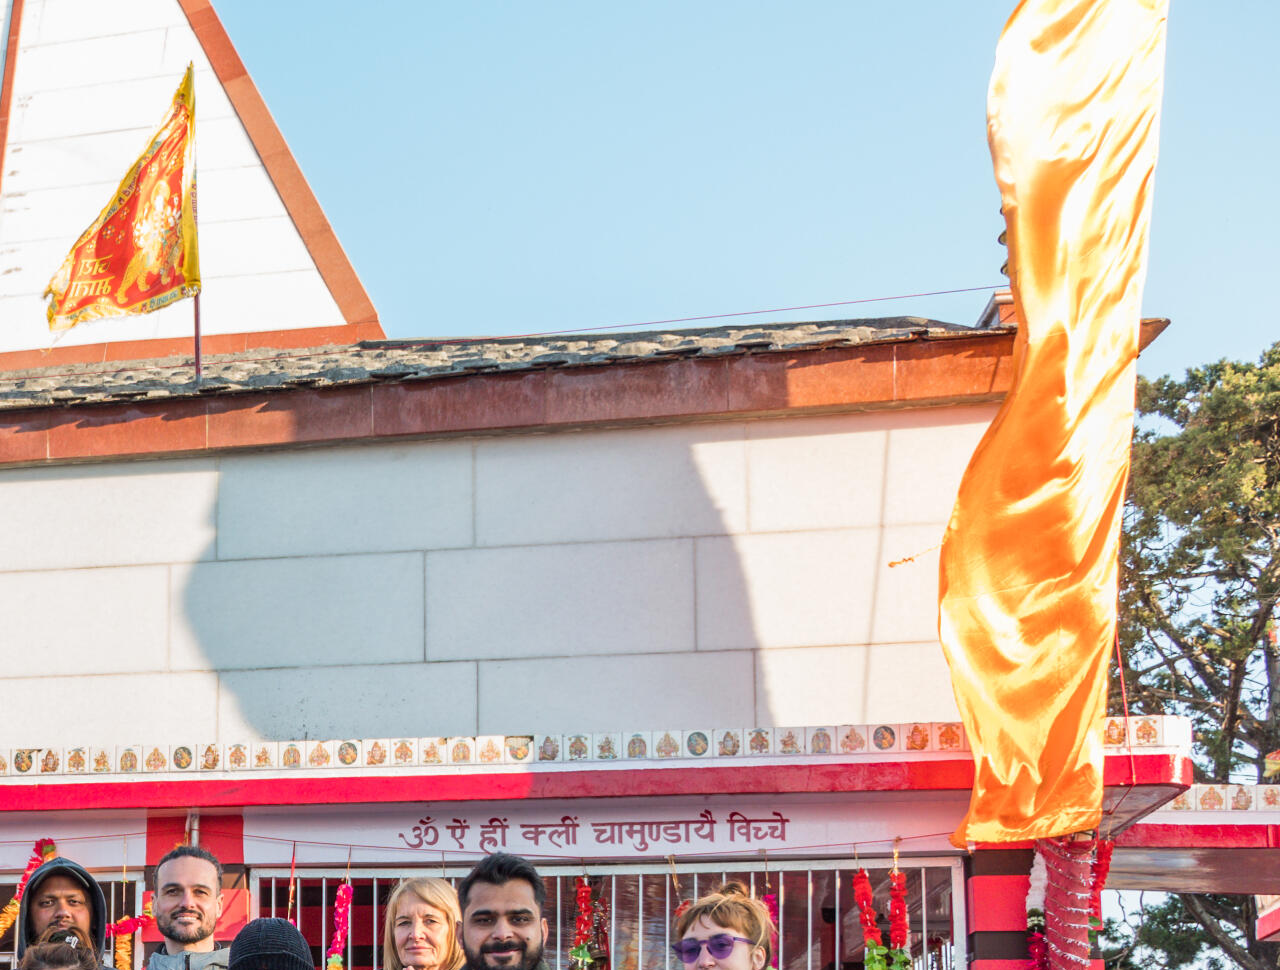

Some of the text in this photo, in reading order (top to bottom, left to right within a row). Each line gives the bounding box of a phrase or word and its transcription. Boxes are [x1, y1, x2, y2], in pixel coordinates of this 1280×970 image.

[445, 818, 471, 849] ऐं
[590, 809, 718, 852] चामुण्डायै
[726, 811, 791, 843] विच्चे
